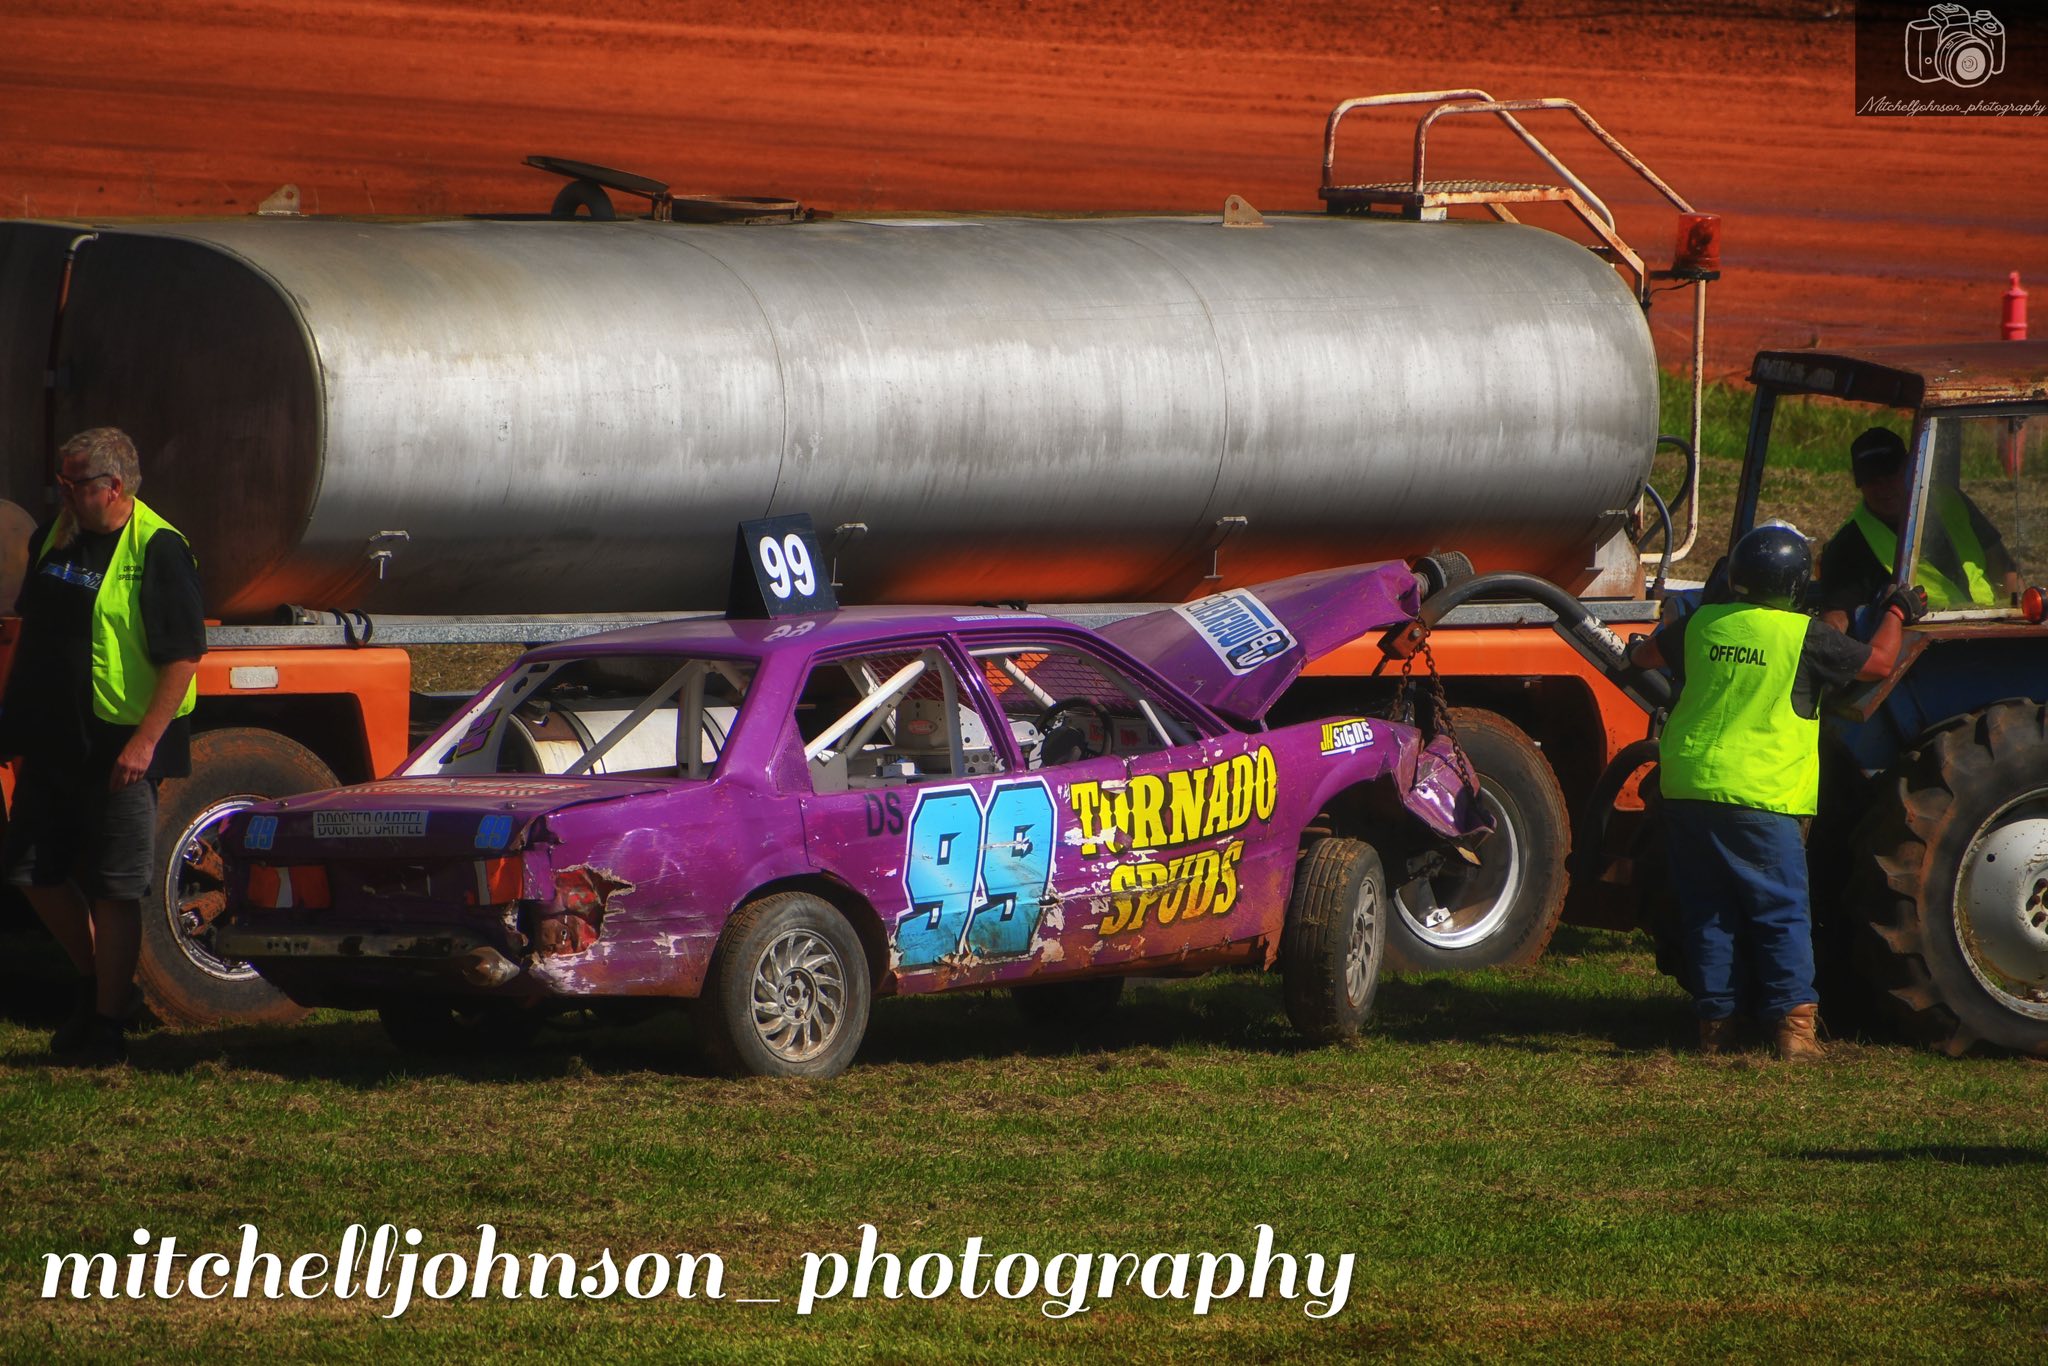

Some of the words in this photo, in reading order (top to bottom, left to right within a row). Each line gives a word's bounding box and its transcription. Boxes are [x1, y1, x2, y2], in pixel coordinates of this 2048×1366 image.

[759, 533, 816, 599] 99
[1709, 645, 1767, 667] OFFICIAL
[316, 812, 371, 836] BOOSTED
[374, 811, 423, 835] CARTEL
[864, 791, 905, 837] DS
[1070, 744, 1279, 857] TORNADO
[244, 815, 279, 850] 99
[474, 815, 513, 849] 99
[896, 775, 1058, 967] 99
[1098, 839, 1245, 937] SPUDS
